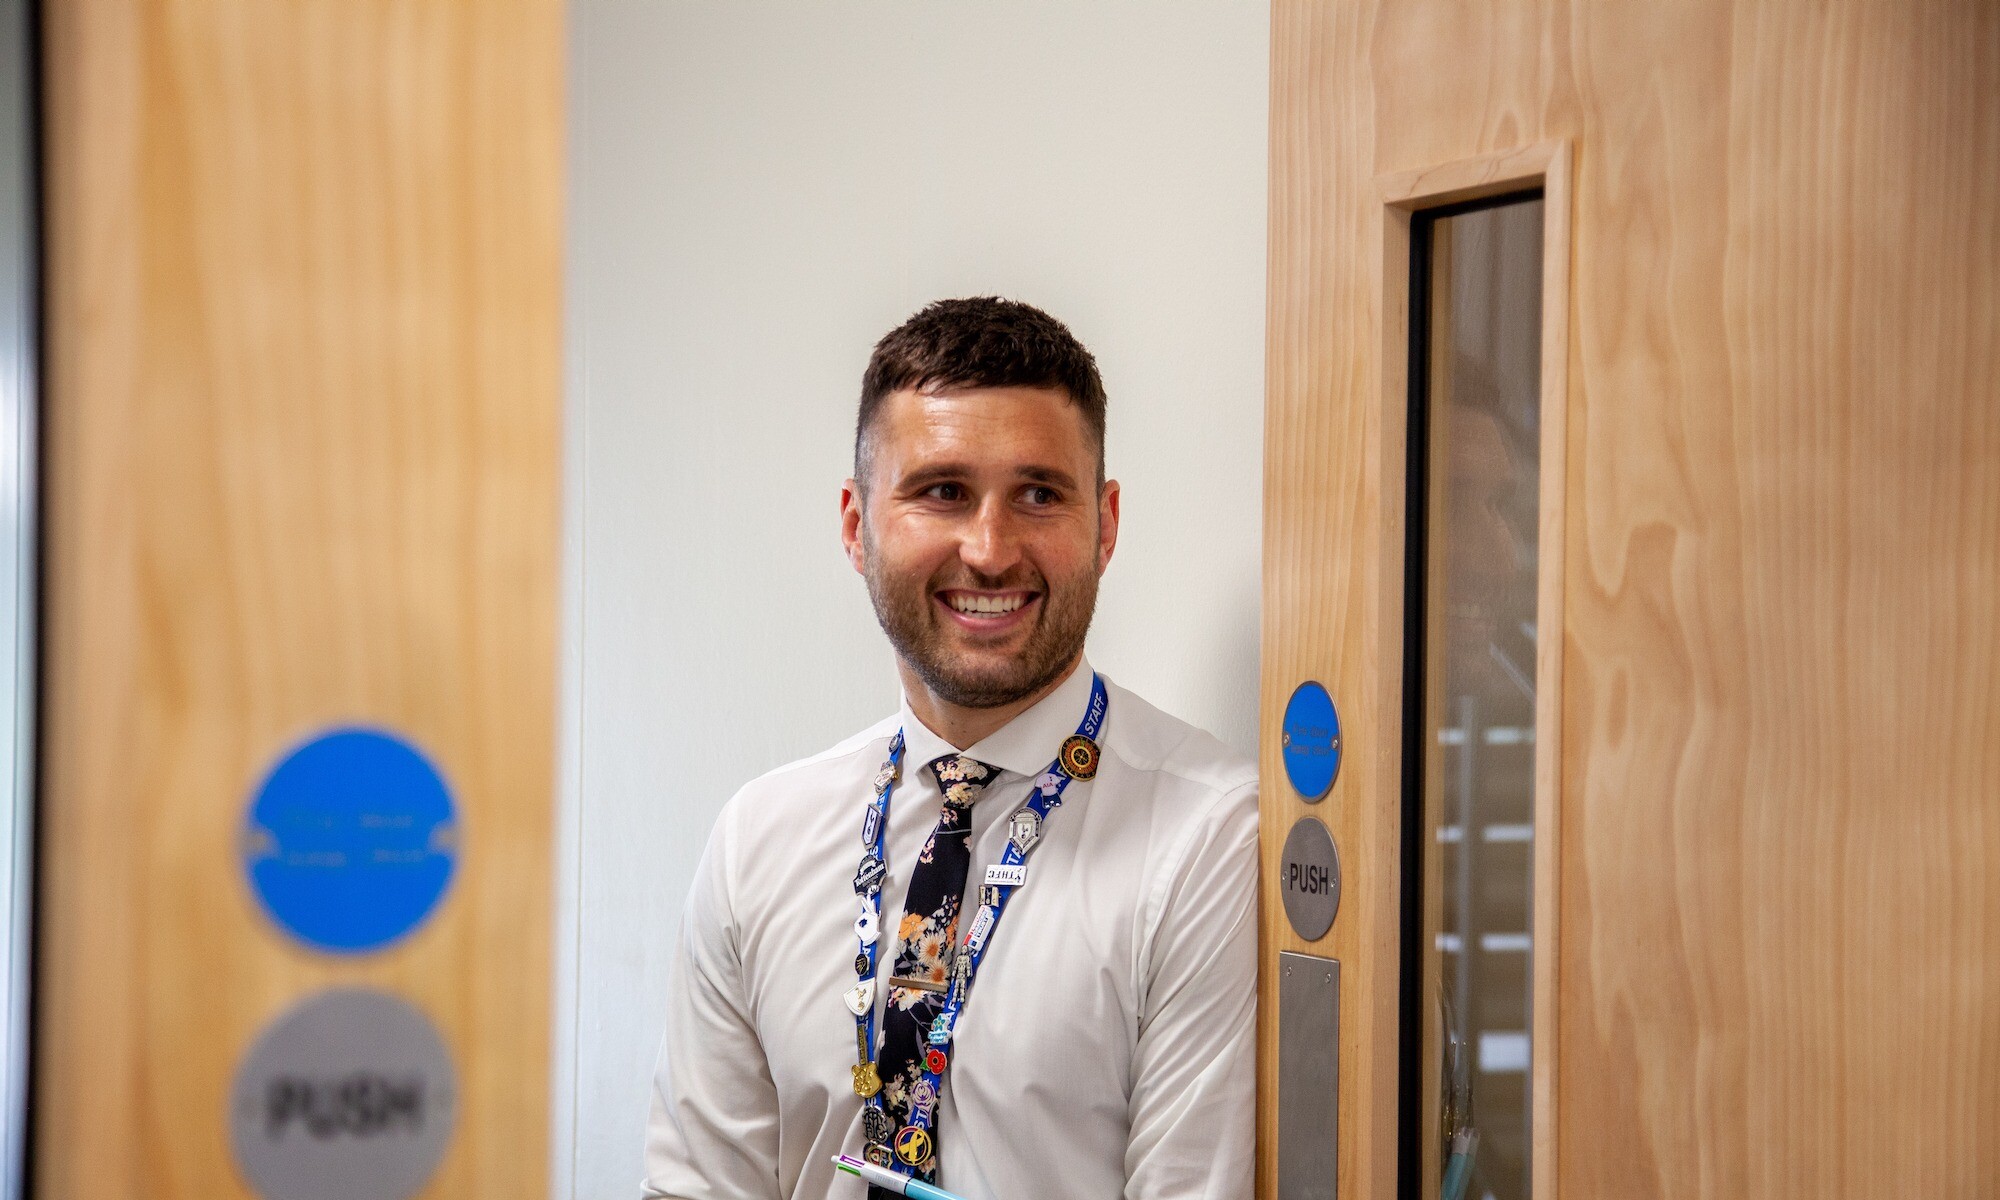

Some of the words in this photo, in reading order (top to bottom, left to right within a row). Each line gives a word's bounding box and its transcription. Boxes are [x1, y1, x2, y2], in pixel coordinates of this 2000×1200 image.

[1084, 692, 1104, 735] STAFF
[988, 869, 1014, 880] THFC
[1290, 863, 1329, 895] PUSH
[266, 1074, 424, 1139] PUSH
